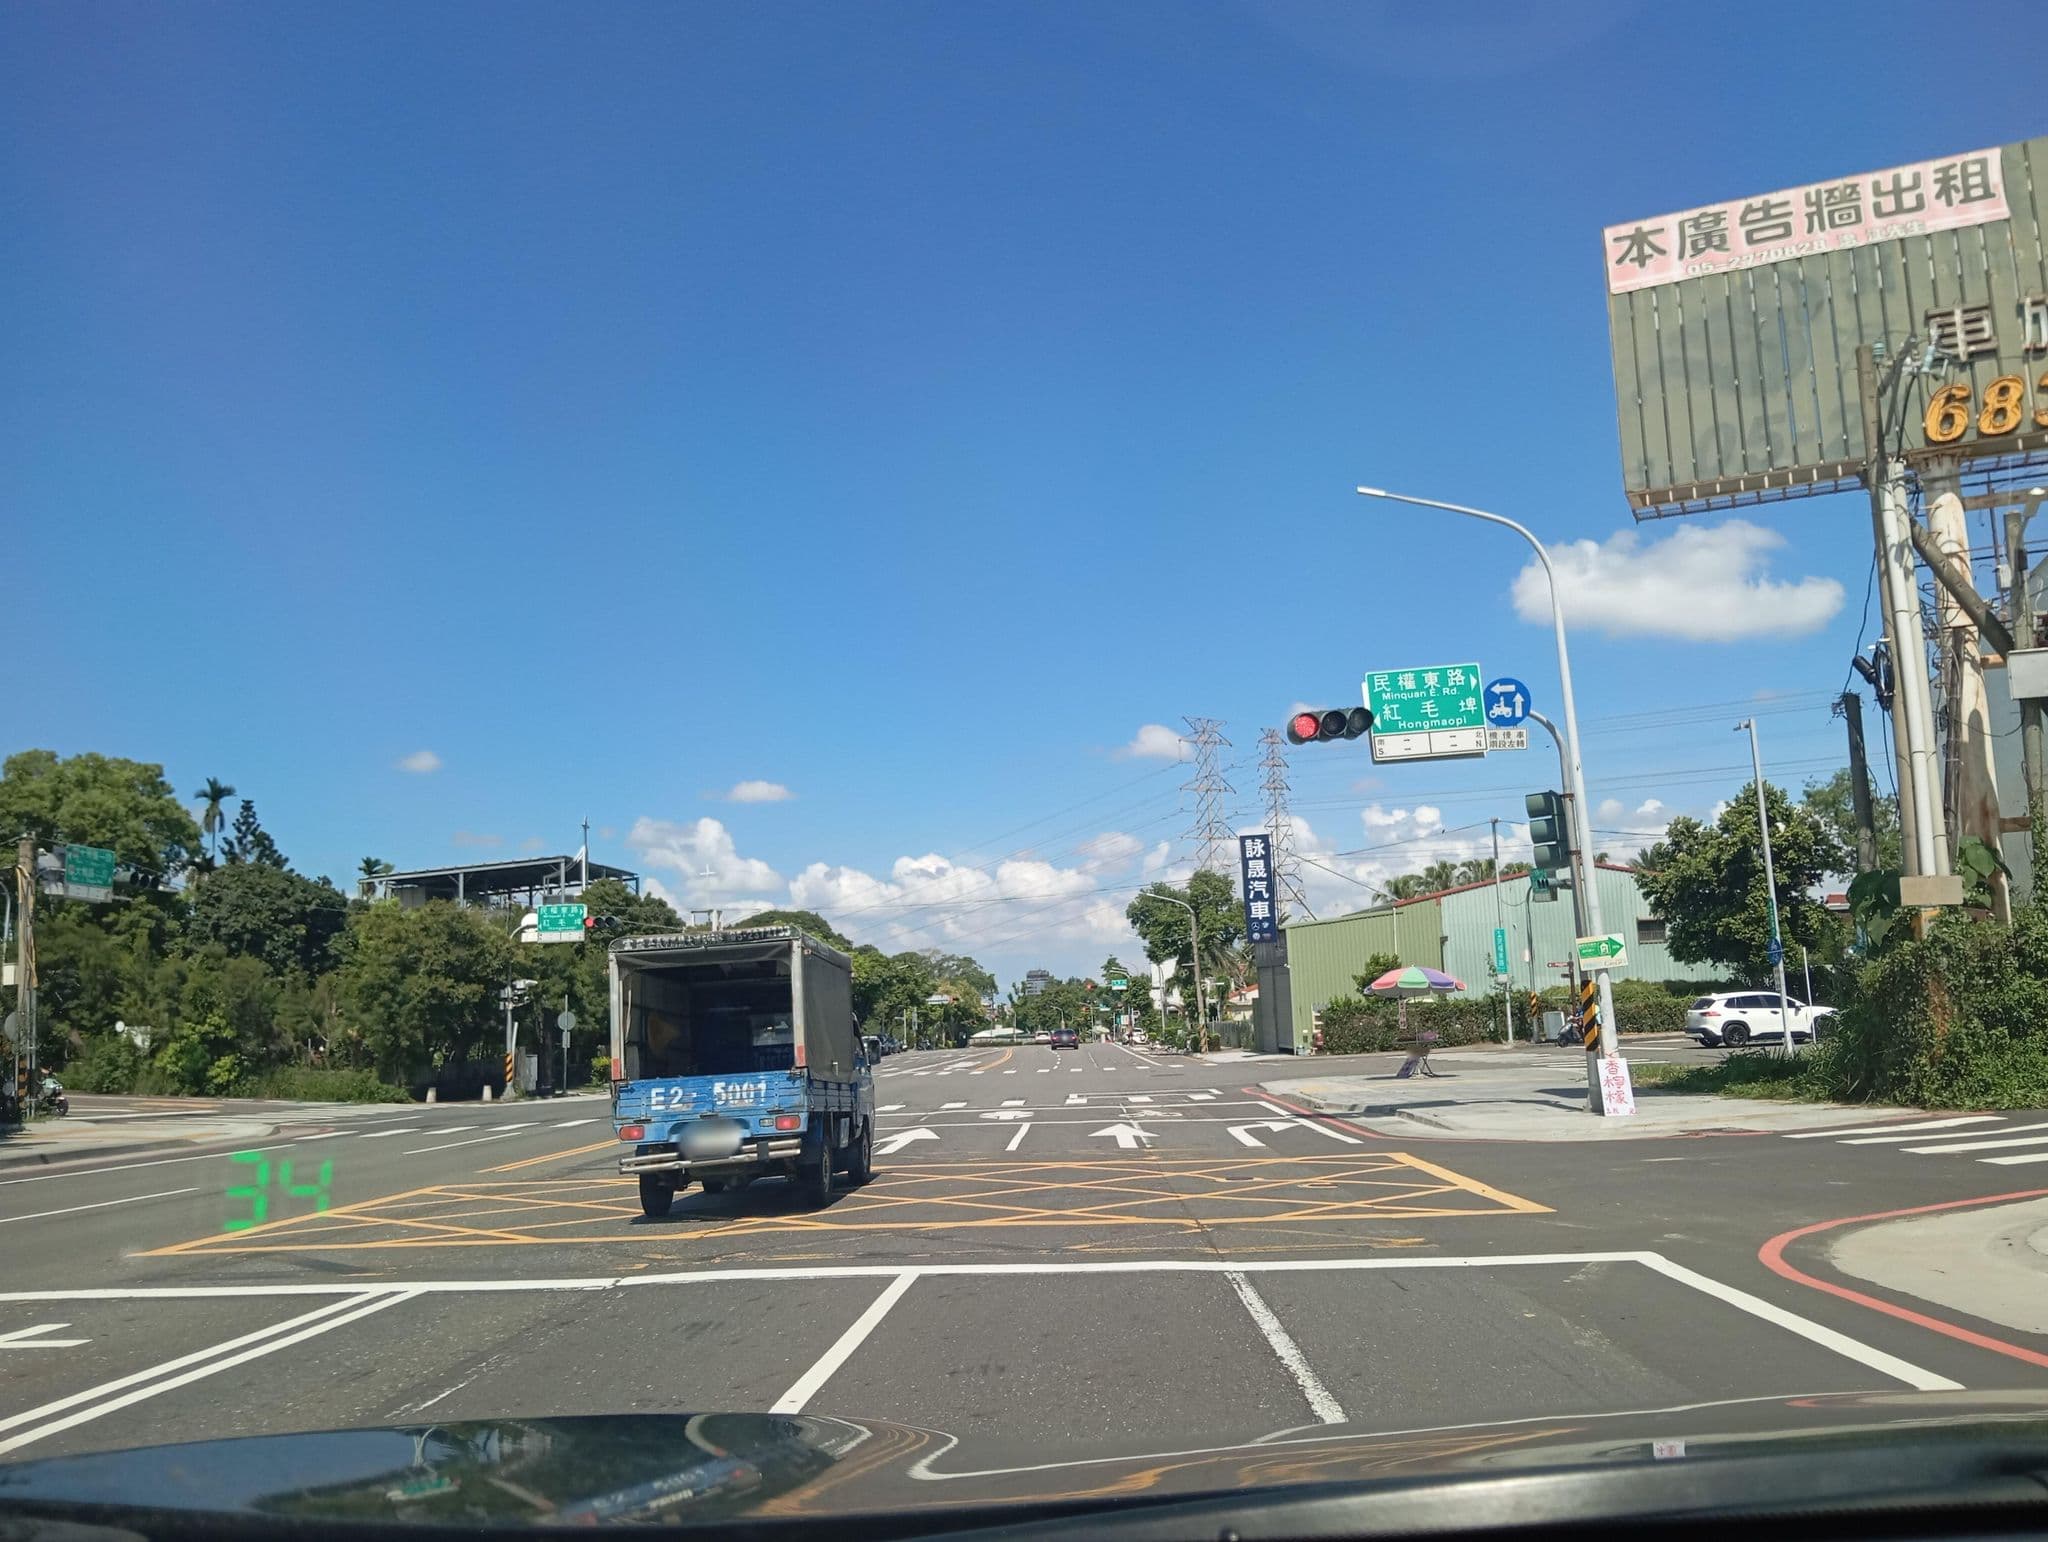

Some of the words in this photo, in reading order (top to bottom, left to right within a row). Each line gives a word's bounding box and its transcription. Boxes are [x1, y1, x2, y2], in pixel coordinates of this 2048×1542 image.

[1612, 157, 1997, 269] 本廣告牆出租
[1373, 668, 1466, 693] 民權東路
[1382, 690, 1427, 702] Minquan
[1429, 688, 1440, 697] E.
[1442, 686, 1460, 696] Rd.
[1382, 696, 1478, 722] 紅毛埤
[1398, 715, 1467, 730] Hongmaopi
[1244, 838, 1271, 920] 詠晟汽車
[223, 1150, 335, 1232] 34
